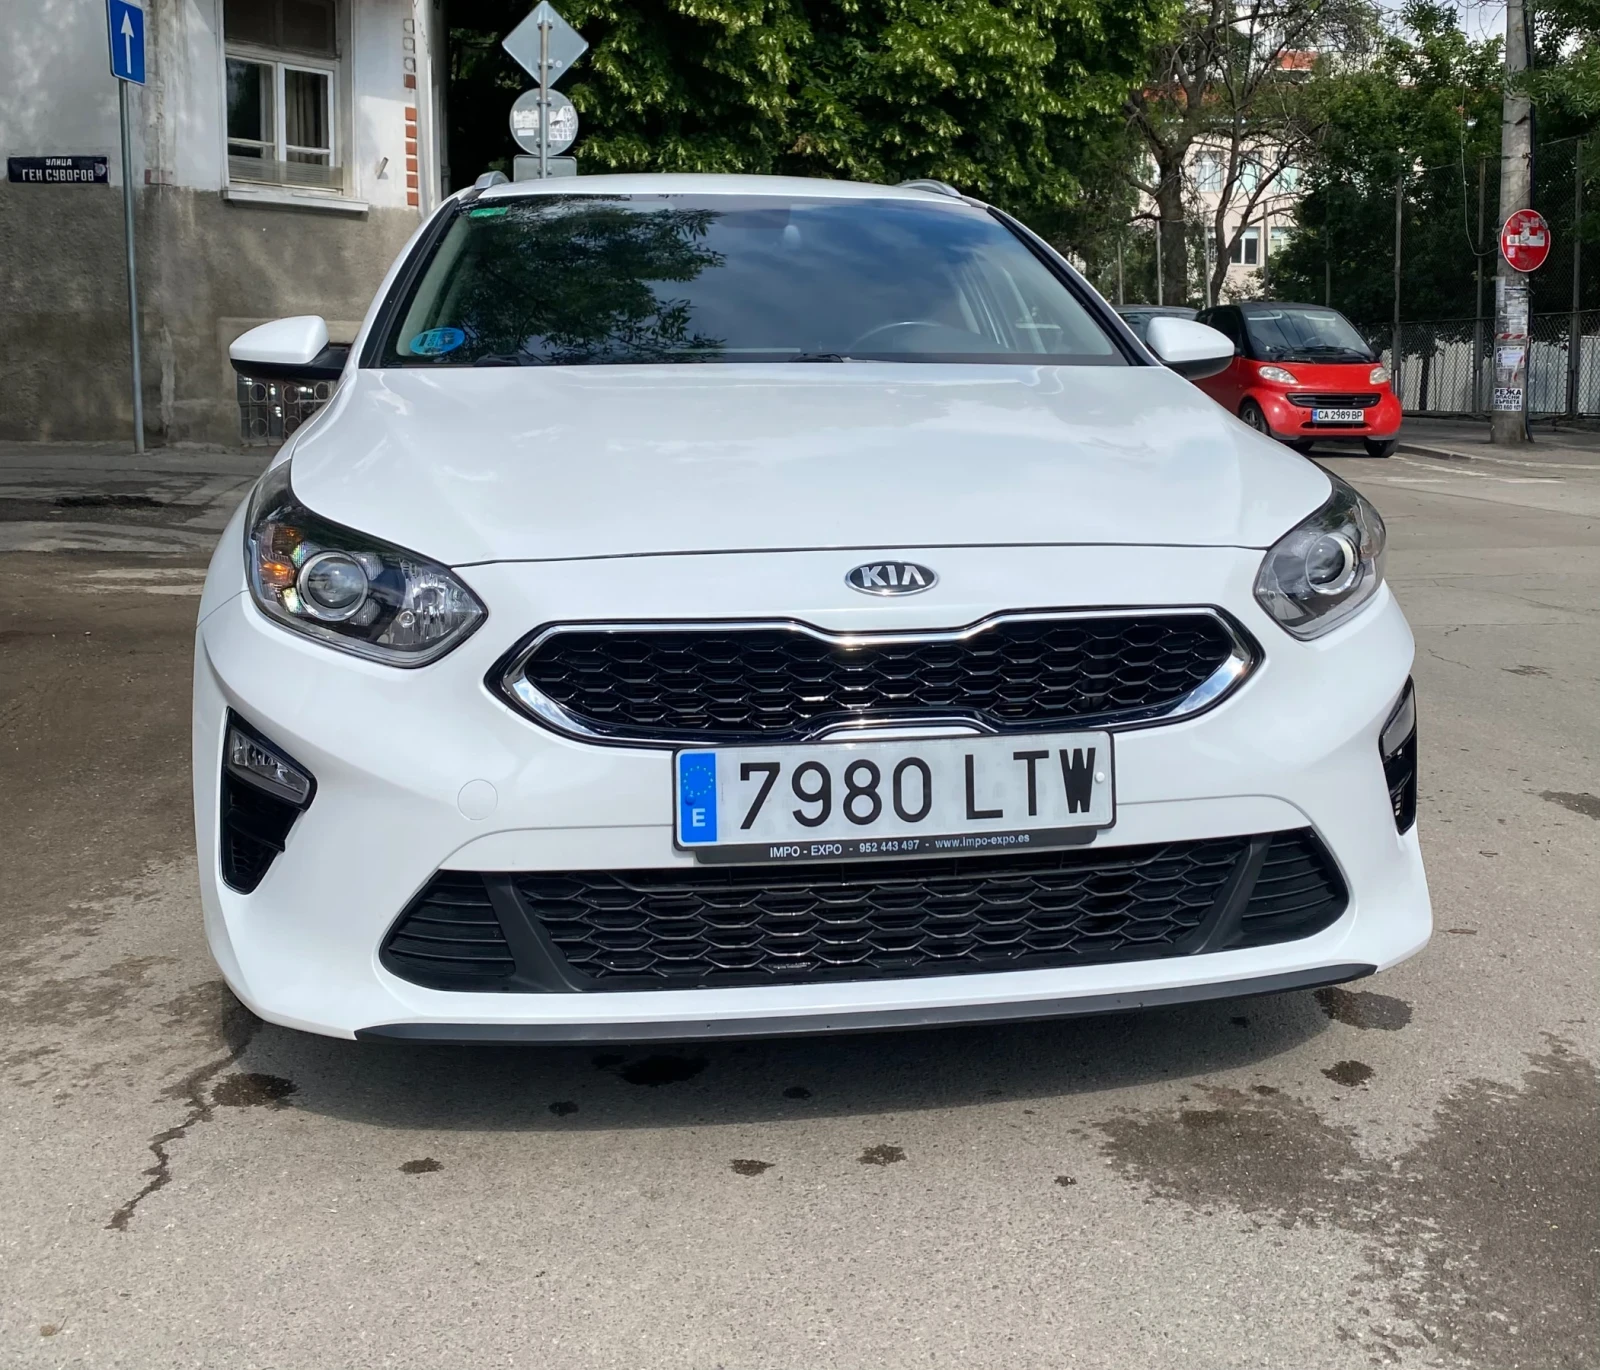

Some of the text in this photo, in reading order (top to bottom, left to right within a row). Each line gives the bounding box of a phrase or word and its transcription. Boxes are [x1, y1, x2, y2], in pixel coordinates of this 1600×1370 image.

[45, 158, 72, 166] УЛИЦА
[22, 169, 95, 182] ГЕН СУВОРОВ
[1494, 388, 1522, 396] РЕЖА
[1318, 410, 1363, 420] CA 2989 BP
[859, 564, 926, 587] KIA
[739, 747, 1096, 830] 7980 LTW
[692, 807, 706, 828] E
[769, 845, 801, 858] IMPO
[810, 843, 842, 856] EXPO
[859, 842, 878, 853] 952
[880, 840, 899, 852] 443
[901, 839, 920, 850] 497
[935, 834, 1030, 848] www.impo-expo.es
